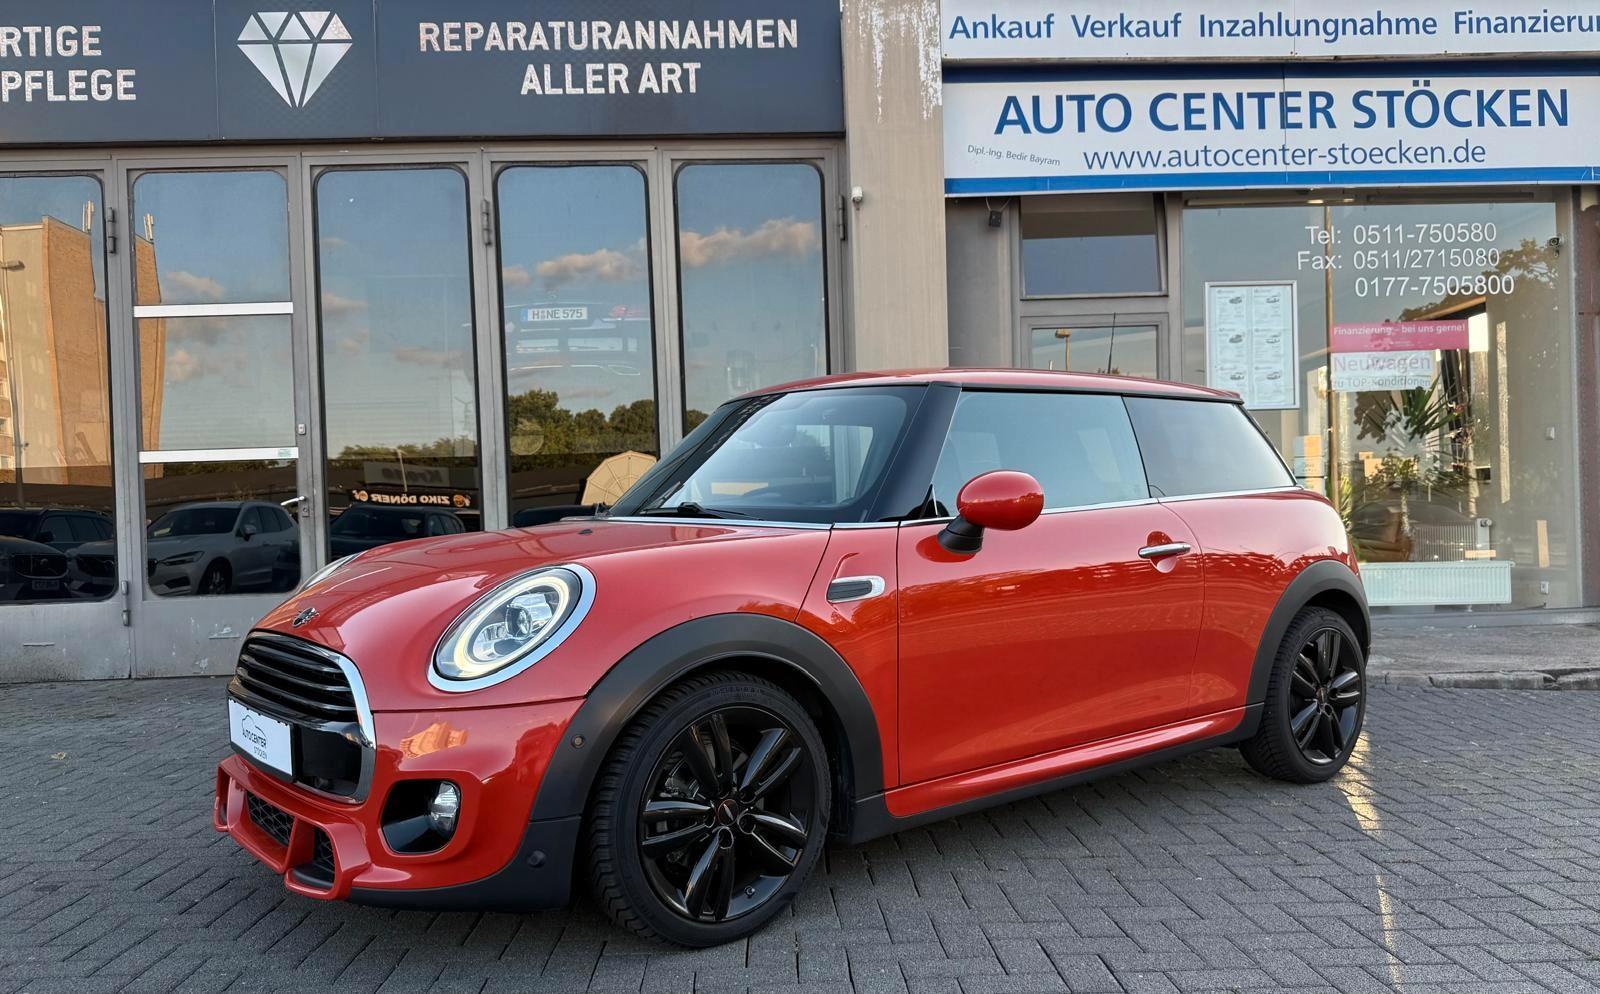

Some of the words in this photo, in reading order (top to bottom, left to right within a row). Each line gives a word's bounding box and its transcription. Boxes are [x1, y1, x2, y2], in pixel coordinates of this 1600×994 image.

[418, 19, 798, 52] REPARATURANNAHMEN
[949, 13, 1055, 39] Ankauf
[1070, 12, 1182, 38] Verkauf
[1199, 10, 1438, 43] Inzahlungnahme
[1454, 9, 1600, 34] Finanzieru
[0, 25, 102, 57] RTIGE
[1, 69, 137, 102] PFLEGE
[520, 63, 630, 95] ALLER
[638, 62, 701, 94] ART
[993, 93, 1132, 135] AUTO
[1149, 91, 1337, 132] CENTER
[1352, 79, 1569, 129] STÖCKEN
[967, 144, 1004, 160] Dipl.-Ing.
[1006, 150, 1028, 161] Bedir
[1029, 153, 1061, 166] Bayram
[1083, 139, 1486, 170] www.autocenter-stoecken.de
[1305, 225, 1342, 245] Tel:
[1353, 222, 1498, 246] 0511-750580
[1297, 251, 1343, 271] Fax:
[1353, 247, 1500, 270] 0511/2715080
[1355, 274, 1515, 297] 0177-7505800
[562, 308, 583, 319] 575
[1333, 326, 1392, 337] Finanzierung
[1401, 324, 1416, 334] bei
[1418, 325, 1434, 333] uns
[1436, 322, 1466, 335] gerne!
[1334, 354, 1431, 374] Neuwagen
